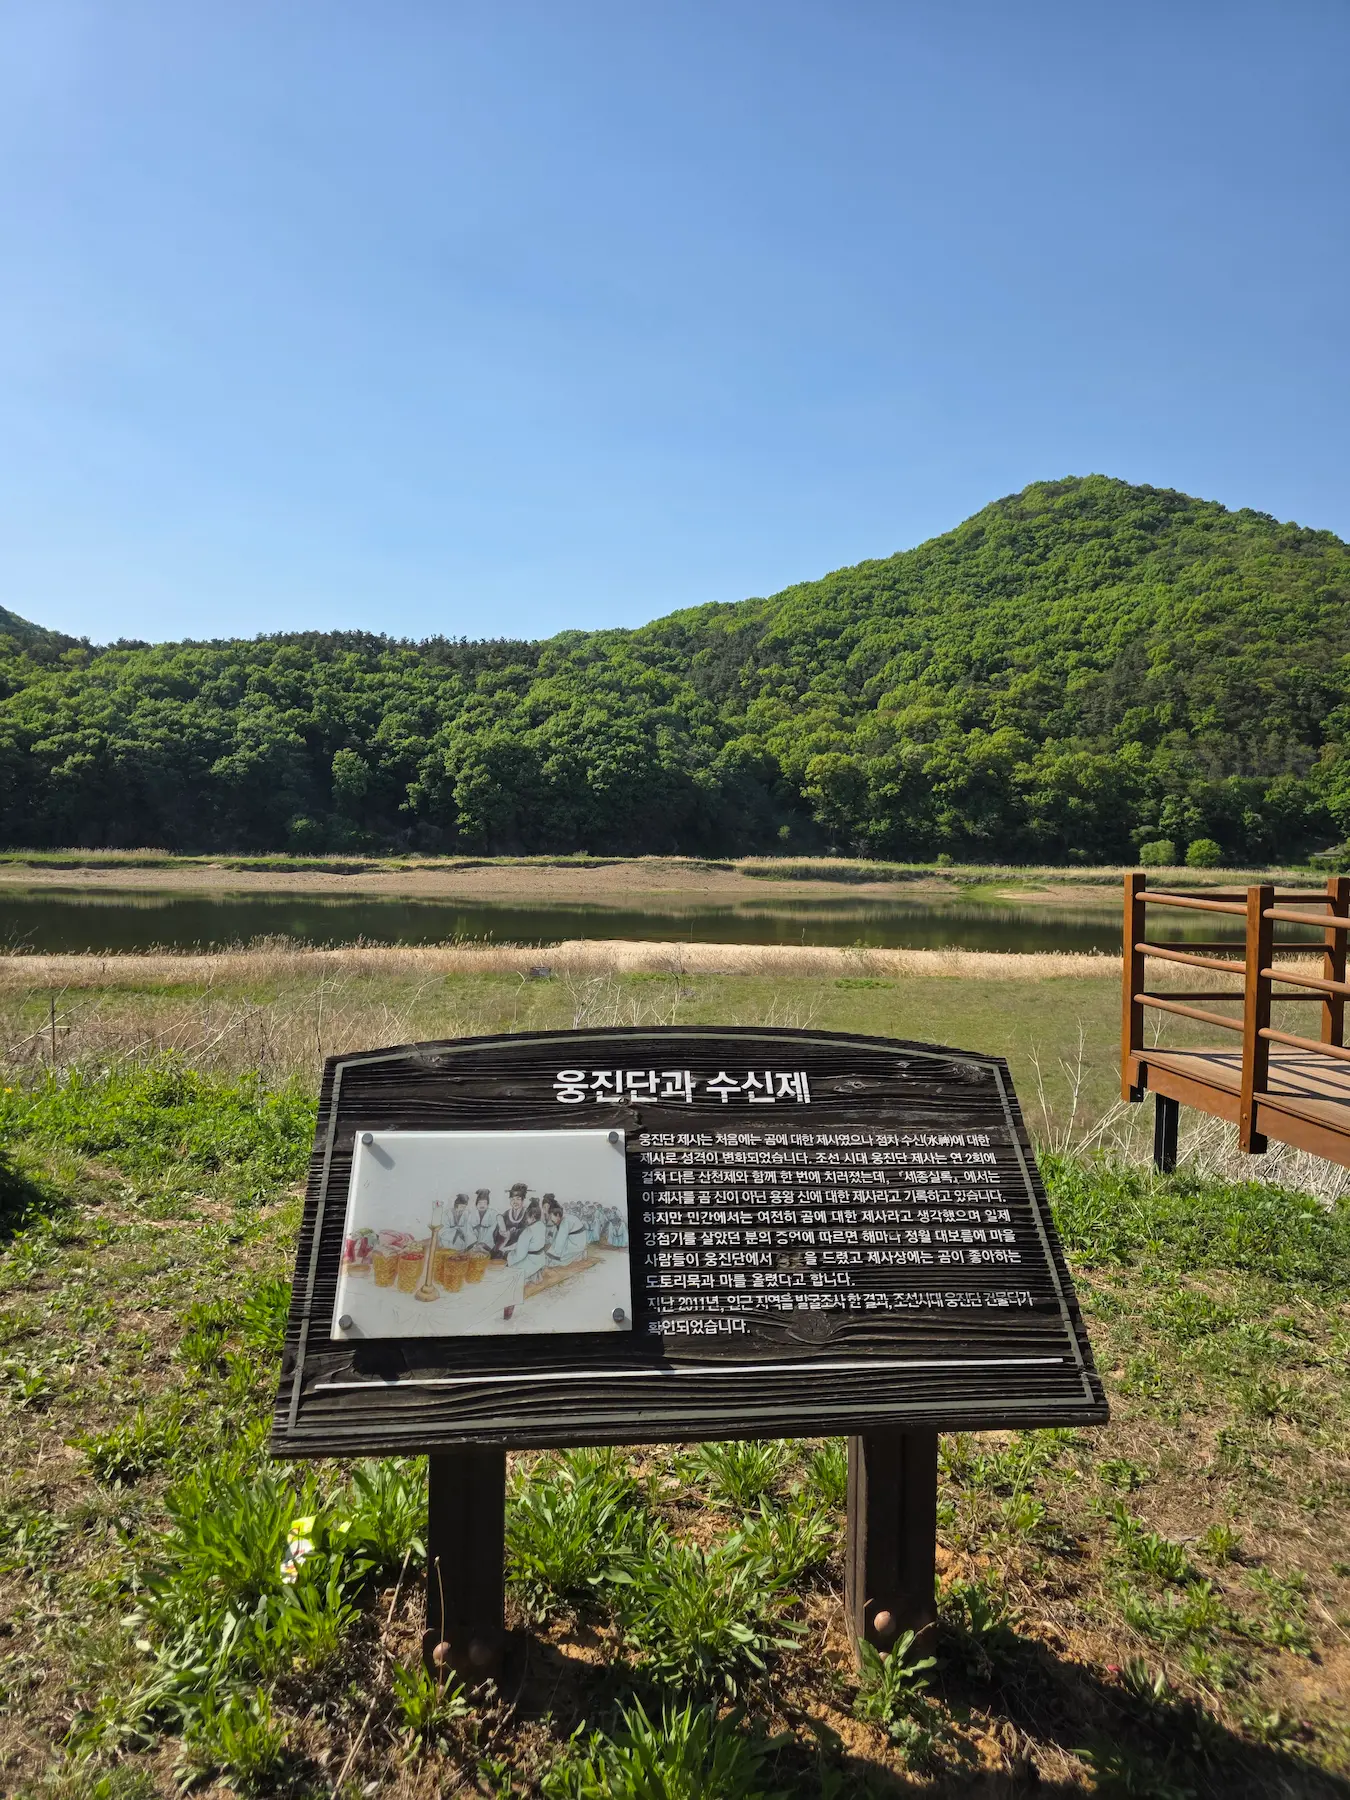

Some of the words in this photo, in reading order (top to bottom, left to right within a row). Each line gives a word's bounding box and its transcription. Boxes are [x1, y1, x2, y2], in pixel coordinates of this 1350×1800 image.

[552, 1069, 696, 1104] 웅진단과
[706, 1071, 811, 1104] 수신제
[639, 1134, 675, 1146] 웅진단
[677, 1134, 713, 1146] 제사는
[715, 1134, 762, 1146] 처음에는
[764, 1134, 787, 1146] 곰에
[790, 1134, 814, 1146] 대한
[816, 1134, 873, 1146] 제사였으나
[876, 1135, 898, 1147] 점차
[966, 1135, 990, 1146] 대한
[640, 1152, 678, 1165] 제사로
[681, 1152, 718, 1165] 성격이
[722, 1152, 812, 1165] 변화되었습니다.
[815, 1153, 840, 1165] 조선
[844, 1153, 867, 1164] 시대
[871, 1152, 908, 1165] 웅진단
[911, 1153, 948, 1165] 제사는
[950, 1153, 963, 1164] 연
[966, 1153, 996, 1165] 2회에
[641, 1171, 666, 1184] 걸쳐
[669, 1171, 696, 1184] 다른
[698, 1171, 748, 1184] 산천제와
[752, 1171, 777, 1184] 함께
[797, 1171, 821, 1184] 번에
[825, 1171, 890, 1185] 치러졌는데,
[642, 1192, 655, 1204] 이
[658, 1191, 695, 1204] 제사를
[698, 1191, 711, 1204] 곰
[714, 1191, 739, 1204] 신이
[742, 1191, 767, 1204] 아닌
[769, 1190, 795, 1204] 용왕
[797, 1191, 822, 1204] 신에
[826, 1191, 850, 1204] 대한
[852, 1190, 902, 1203] 제사라고
[904, 1190, 952, 1203] 기록하고
[954, 1190, 1006, 1203] 있습니다.
[643, 1211, 682, 1225] 하지만
[687, 1211, 753, 1225] 민간에서는
[758, 1210, 797, 1224] 여전히
[800, 1210, 827, 1224] 곰에
[832, 1210, 857, 1224] 대한
[861, 1210, 914, 1224] 제사라고
[917, 1209, 981, 1223] 생각했으며
[984, 1209, 1011, 1222] 일제
[644, 1232, 696, 1246] 강점기를
[700, 1231, 740, 1245] 살았던
[744, 1231, 772, 1245] 분의
[820, 1231, 858, 1244] 따르면
[862, 1230, 901, 1243] 해마다
[905, 1230, 931, 1243] 정월
[935, 1230, 987, 1243] 대보름에
[990, 1229, 1016, 1243] 마을
[644, 1253, 699, 1267] 사람들이
[704, 1252, 772, 1267] 웅진단에서
[823, 1251, 863, 1264] 드렸고
[867, 1251, 934, 1264] 제사상에는
[938, 1250, 965, 1264] 곰이
[969, 1249, 1021, 1264] 좋아하는
[646, 1274, 715, 1289] 도토리묵과
[719, 1274, 746, 1288] 마를
[752, 1273, 806, 1287] 올렸다고
[810, 1272, 855, 1287] 합니다.
[647, 1297, 674, 1313] 지난
[678, 1295, 724, 1313] 2011년,
[727, 1295, 753, 1311] 인근
[755, 1293, 793, 1311] 지역을
[863, 1294, 892, 1310] 결과,
[893, 1293, 943, 1308] 조선시대
[945, 1292, 983, 1308] 웅진단
[648, 1319, 750, 1336] 확인되었습니다.
